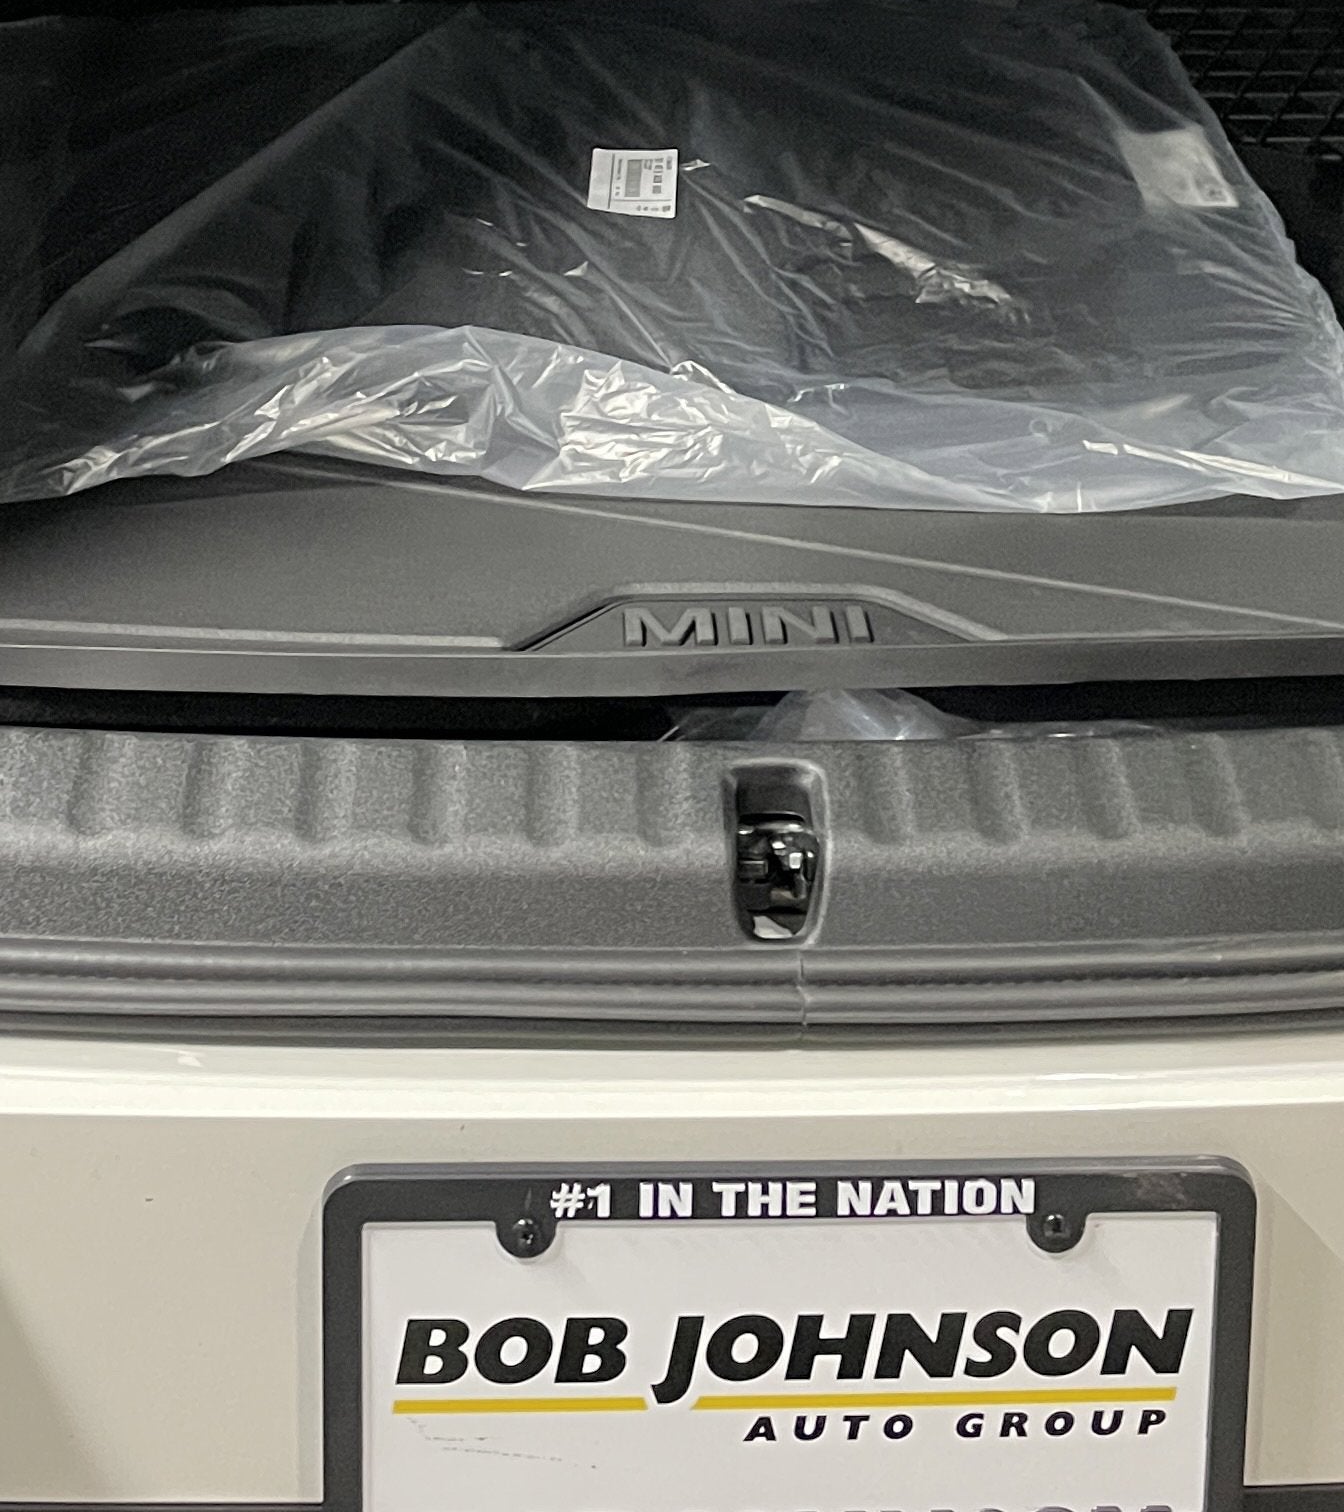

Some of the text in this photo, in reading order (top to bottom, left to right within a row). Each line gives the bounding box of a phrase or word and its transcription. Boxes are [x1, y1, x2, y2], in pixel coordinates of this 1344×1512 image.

[623, 605, 874, 647] MINI
[549, 1177, 1036, 1218] #1 IN THE NATION
[394, 1307, 1195, 1405] BOB JOHNSON
[742, 1408, 1167, 1443] AUTO GROUP
